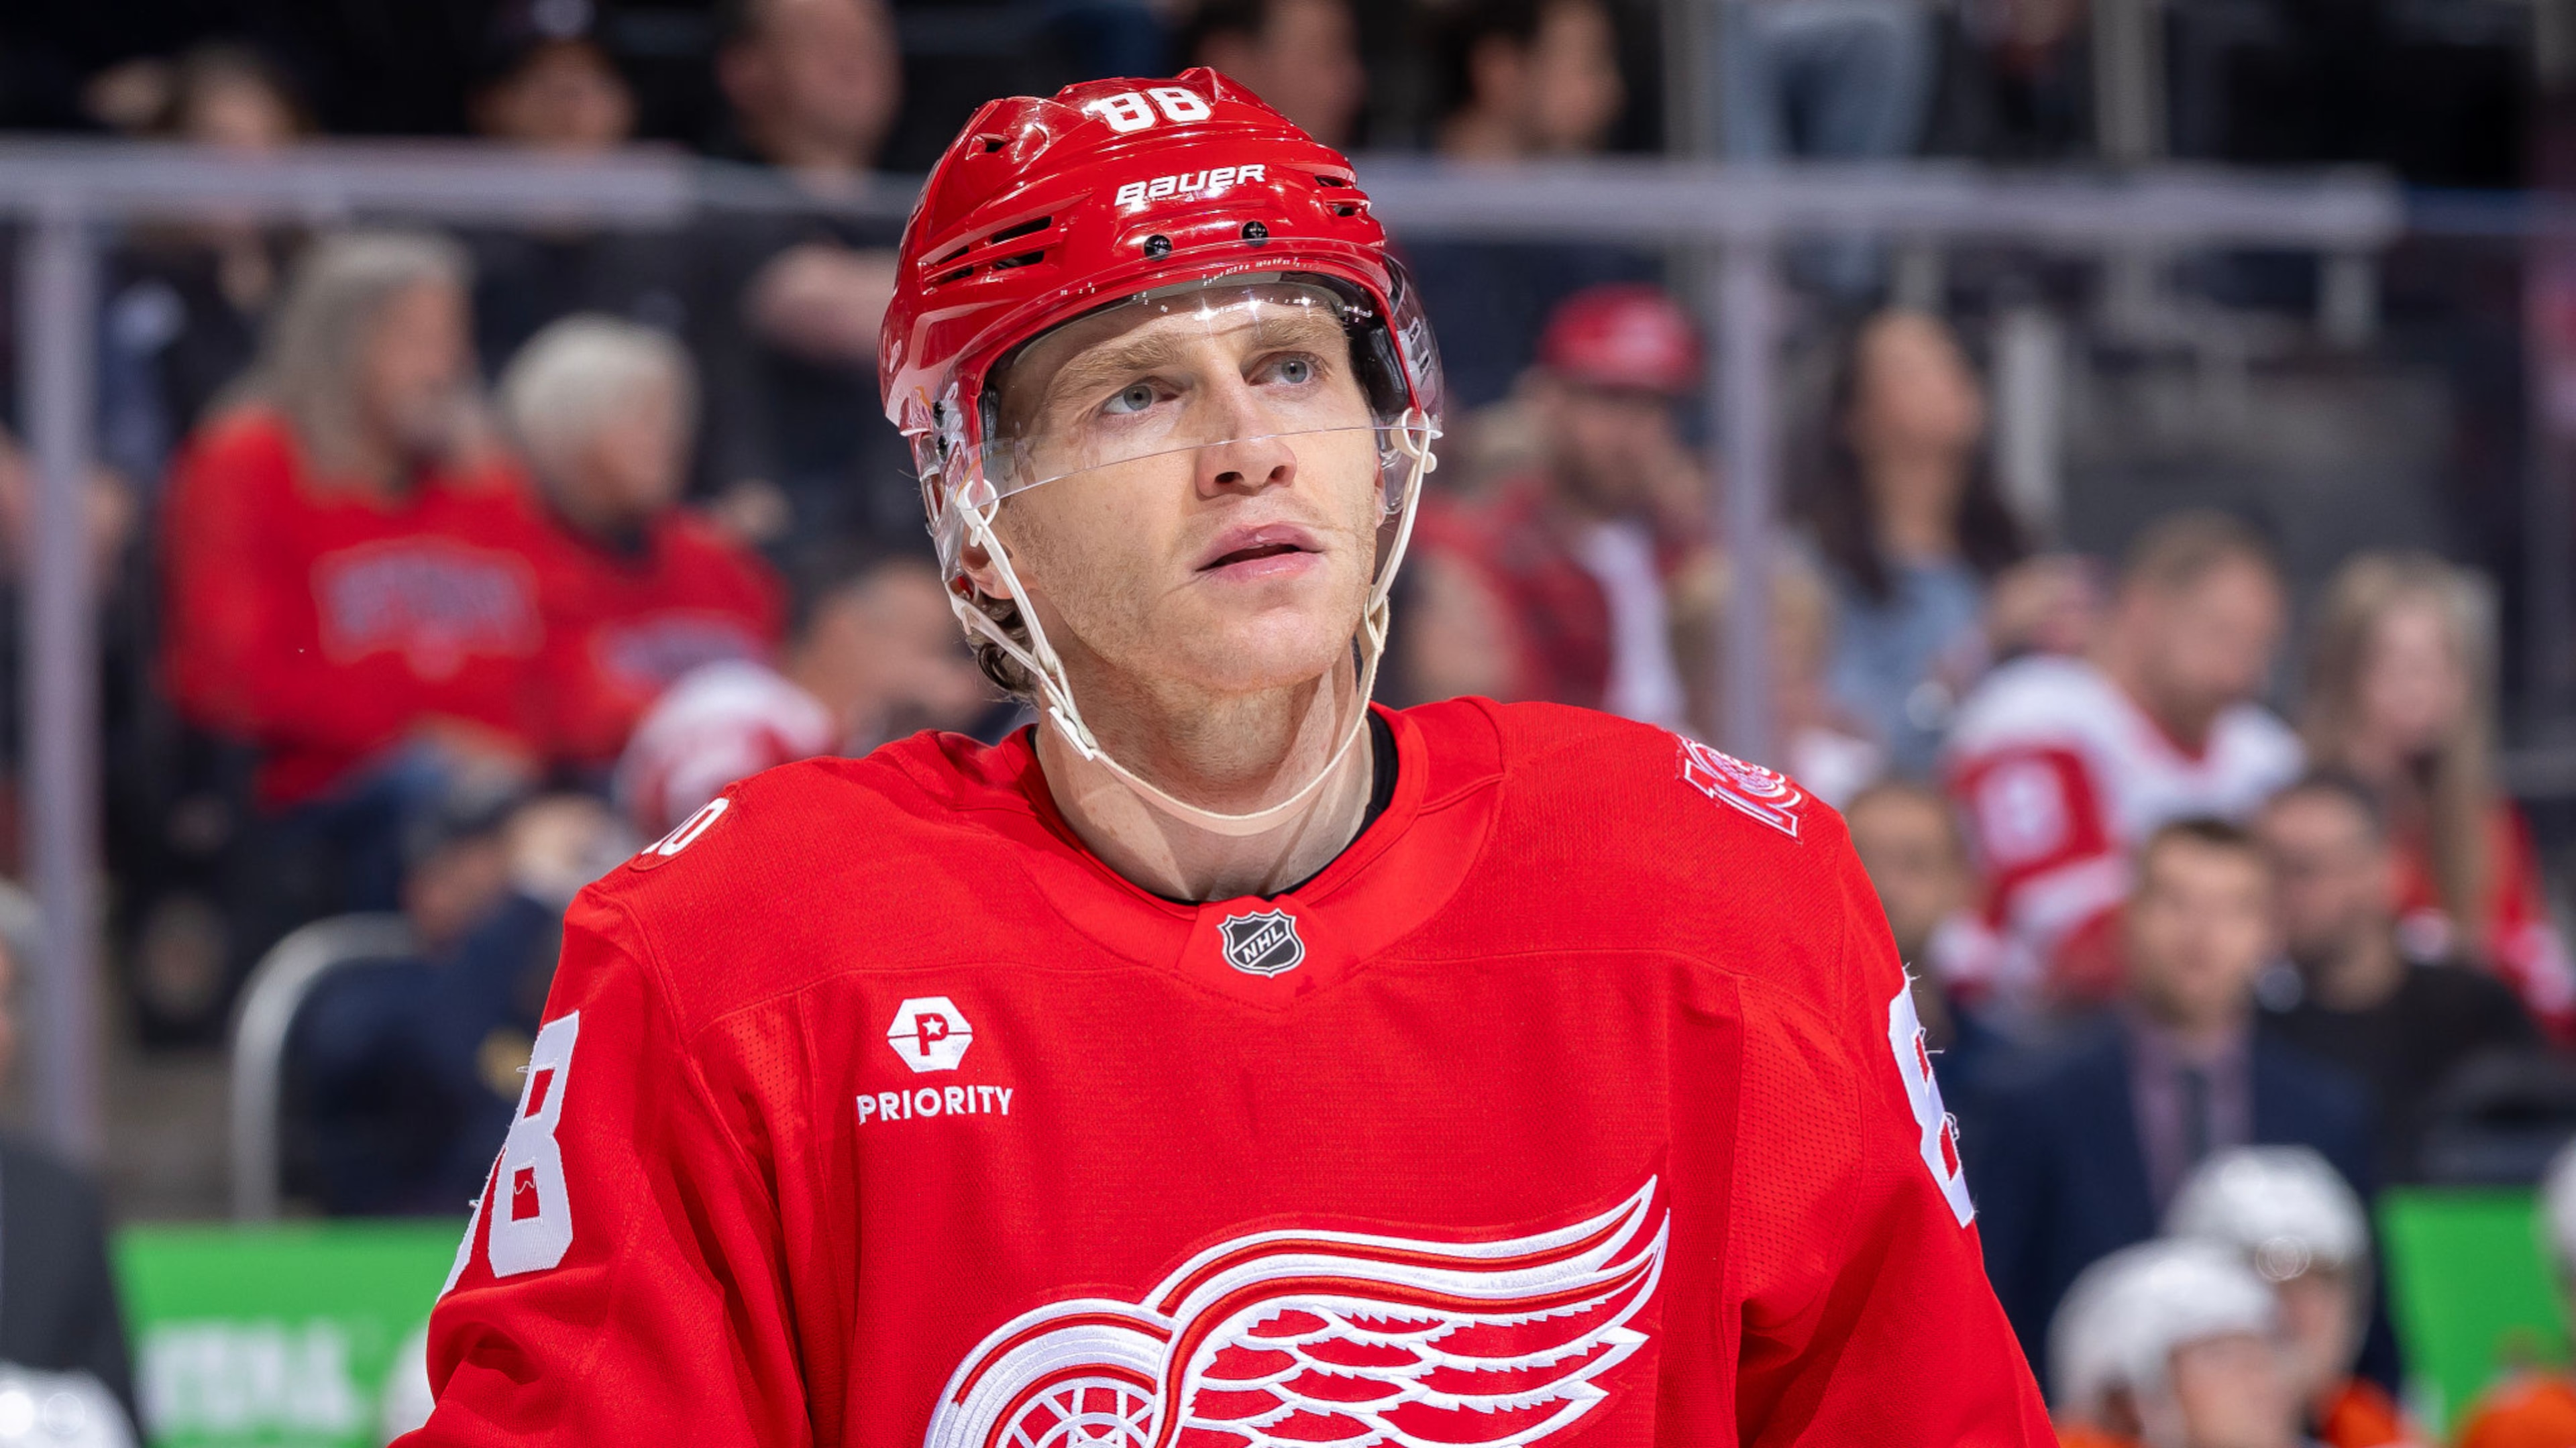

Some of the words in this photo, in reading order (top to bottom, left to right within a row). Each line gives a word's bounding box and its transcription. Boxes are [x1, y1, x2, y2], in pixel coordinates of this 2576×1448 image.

[1093, 87, 1212, 133] 88
[1242, 926, 1284, 964] NHL
[855, 1084, 1014, 1126] PRIORITY
[436, 1009, 580, 1304] 8
